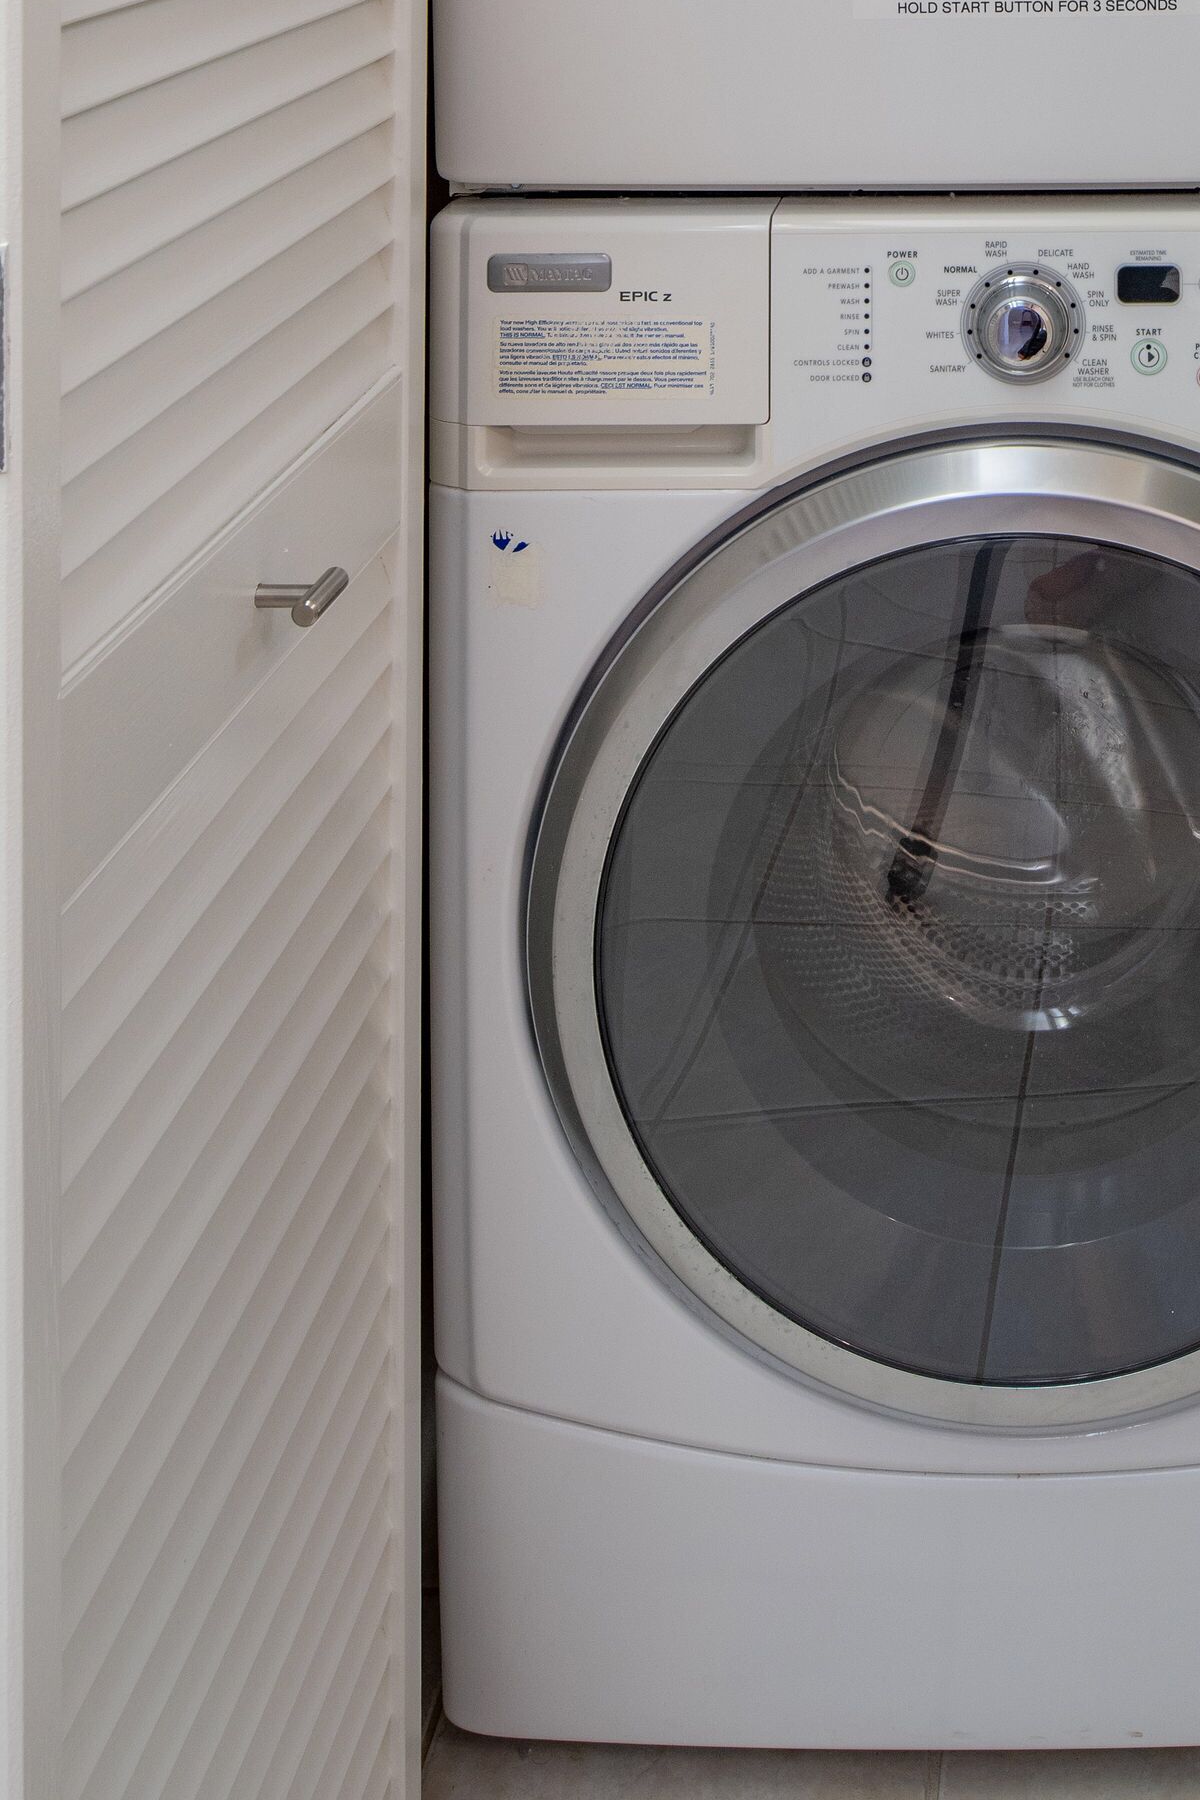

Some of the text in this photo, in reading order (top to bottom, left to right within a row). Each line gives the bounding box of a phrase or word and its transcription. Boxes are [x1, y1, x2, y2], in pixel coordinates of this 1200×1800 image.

[898, 2, 937, 14] HOLD
[942, 1, 990, 14] START
[995, 0, 1054, 13] BUTTON
[1058, 0, 1089, 12] FOR
[1093, 0, 1101, 12] 3
[985, 241, 1007, 249] RAPID
[1038, 249, 1074, 257] DELICATE
[943, 266, 977, 274] NORMAL
[530, 269, 593, 281] MAYTAG
[1072, 271, 1094, 279] WASH
[619, 291, 658, 301] EPIC
[1087, 291, 1104, 299] SPIN
[936, 298, 958, 306] WASH
[925, 331, 954, 339] WHITES
[1136, 328, 1162, 336] START
[1082, 359, 1107, 367] CLEAN
[930, 365, 966, 373] SANITARY
[1077, 367, 1109, 375] WASHER
